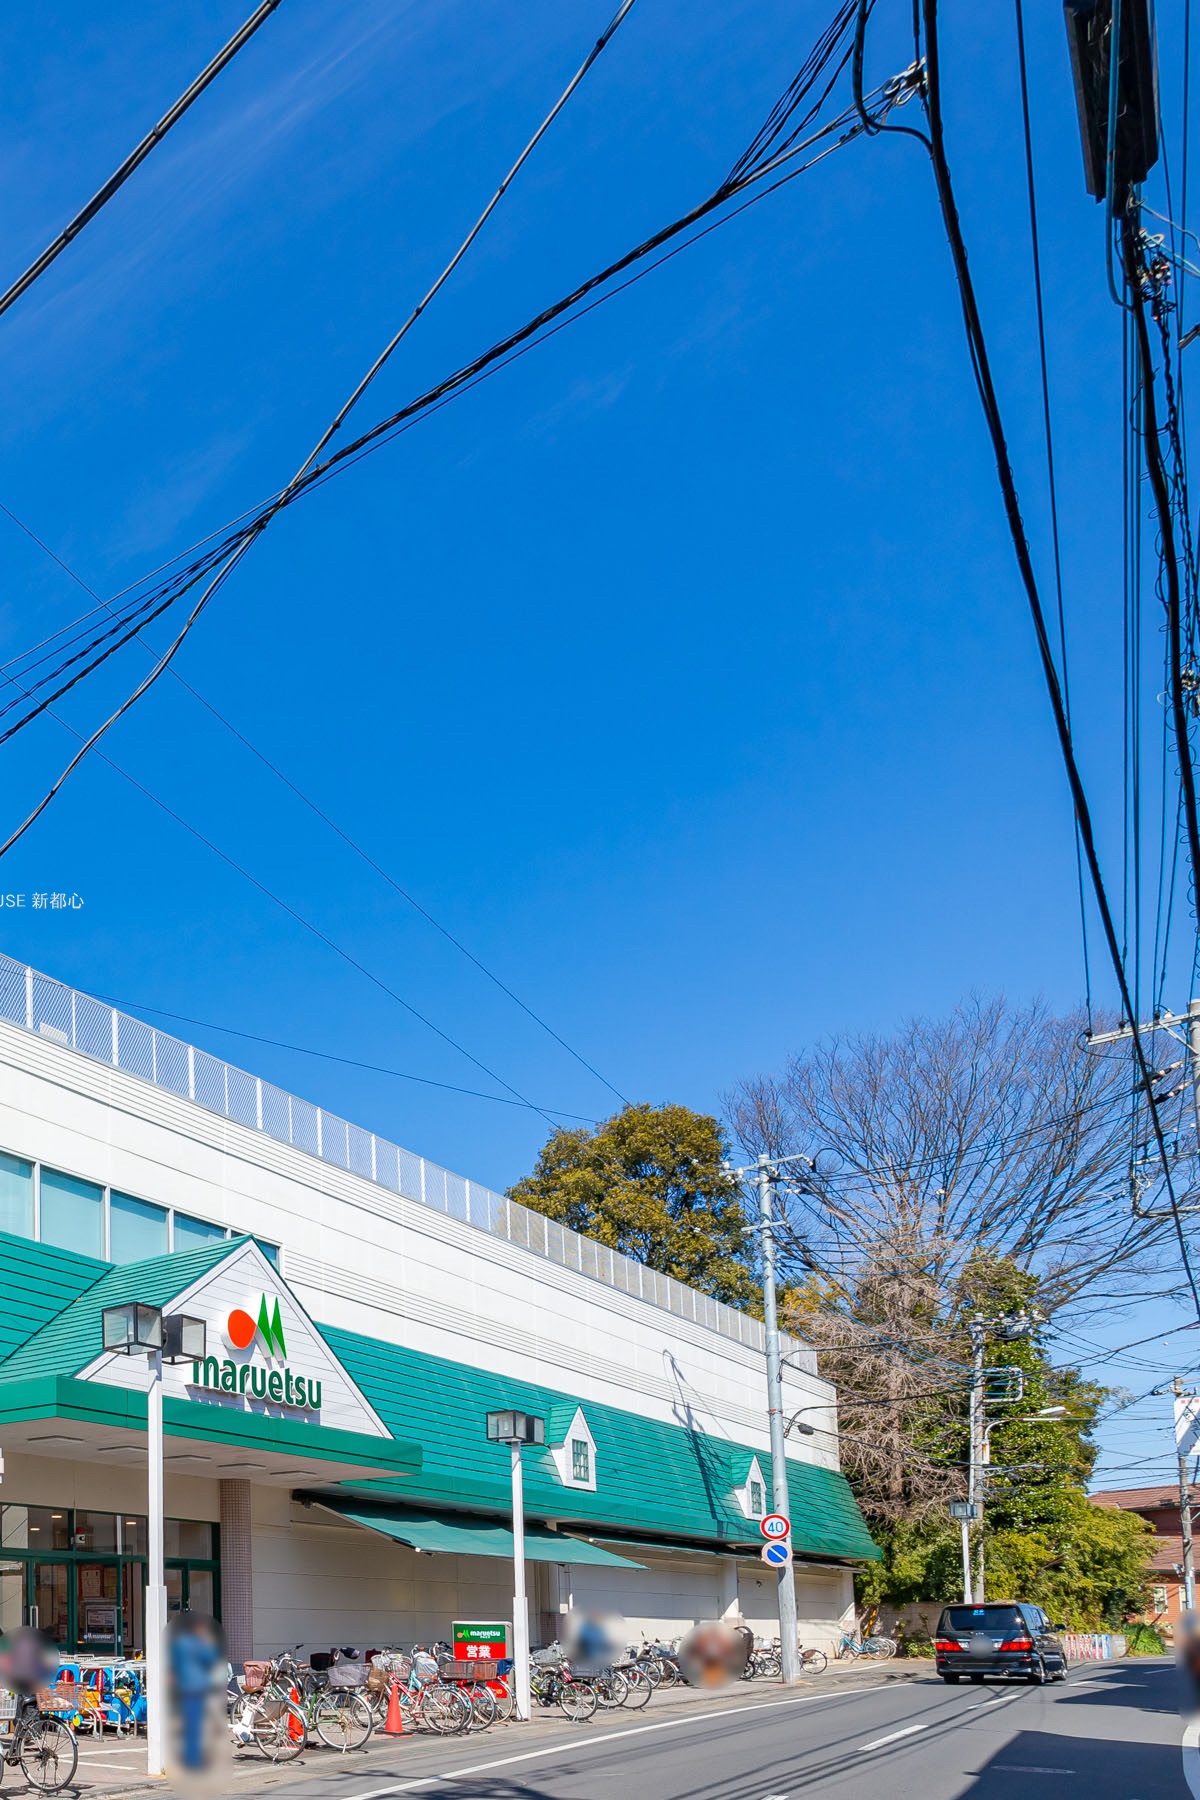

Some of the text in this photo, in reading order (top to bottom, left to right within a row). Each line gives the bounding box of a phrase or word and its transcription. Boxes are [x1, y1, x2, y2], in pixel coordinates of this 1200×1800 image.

[193, 1355, 322, 1410] maruetsu
[767, 1521, 784, 1533] 40
[466, 1644, 492, 1659] 営業
